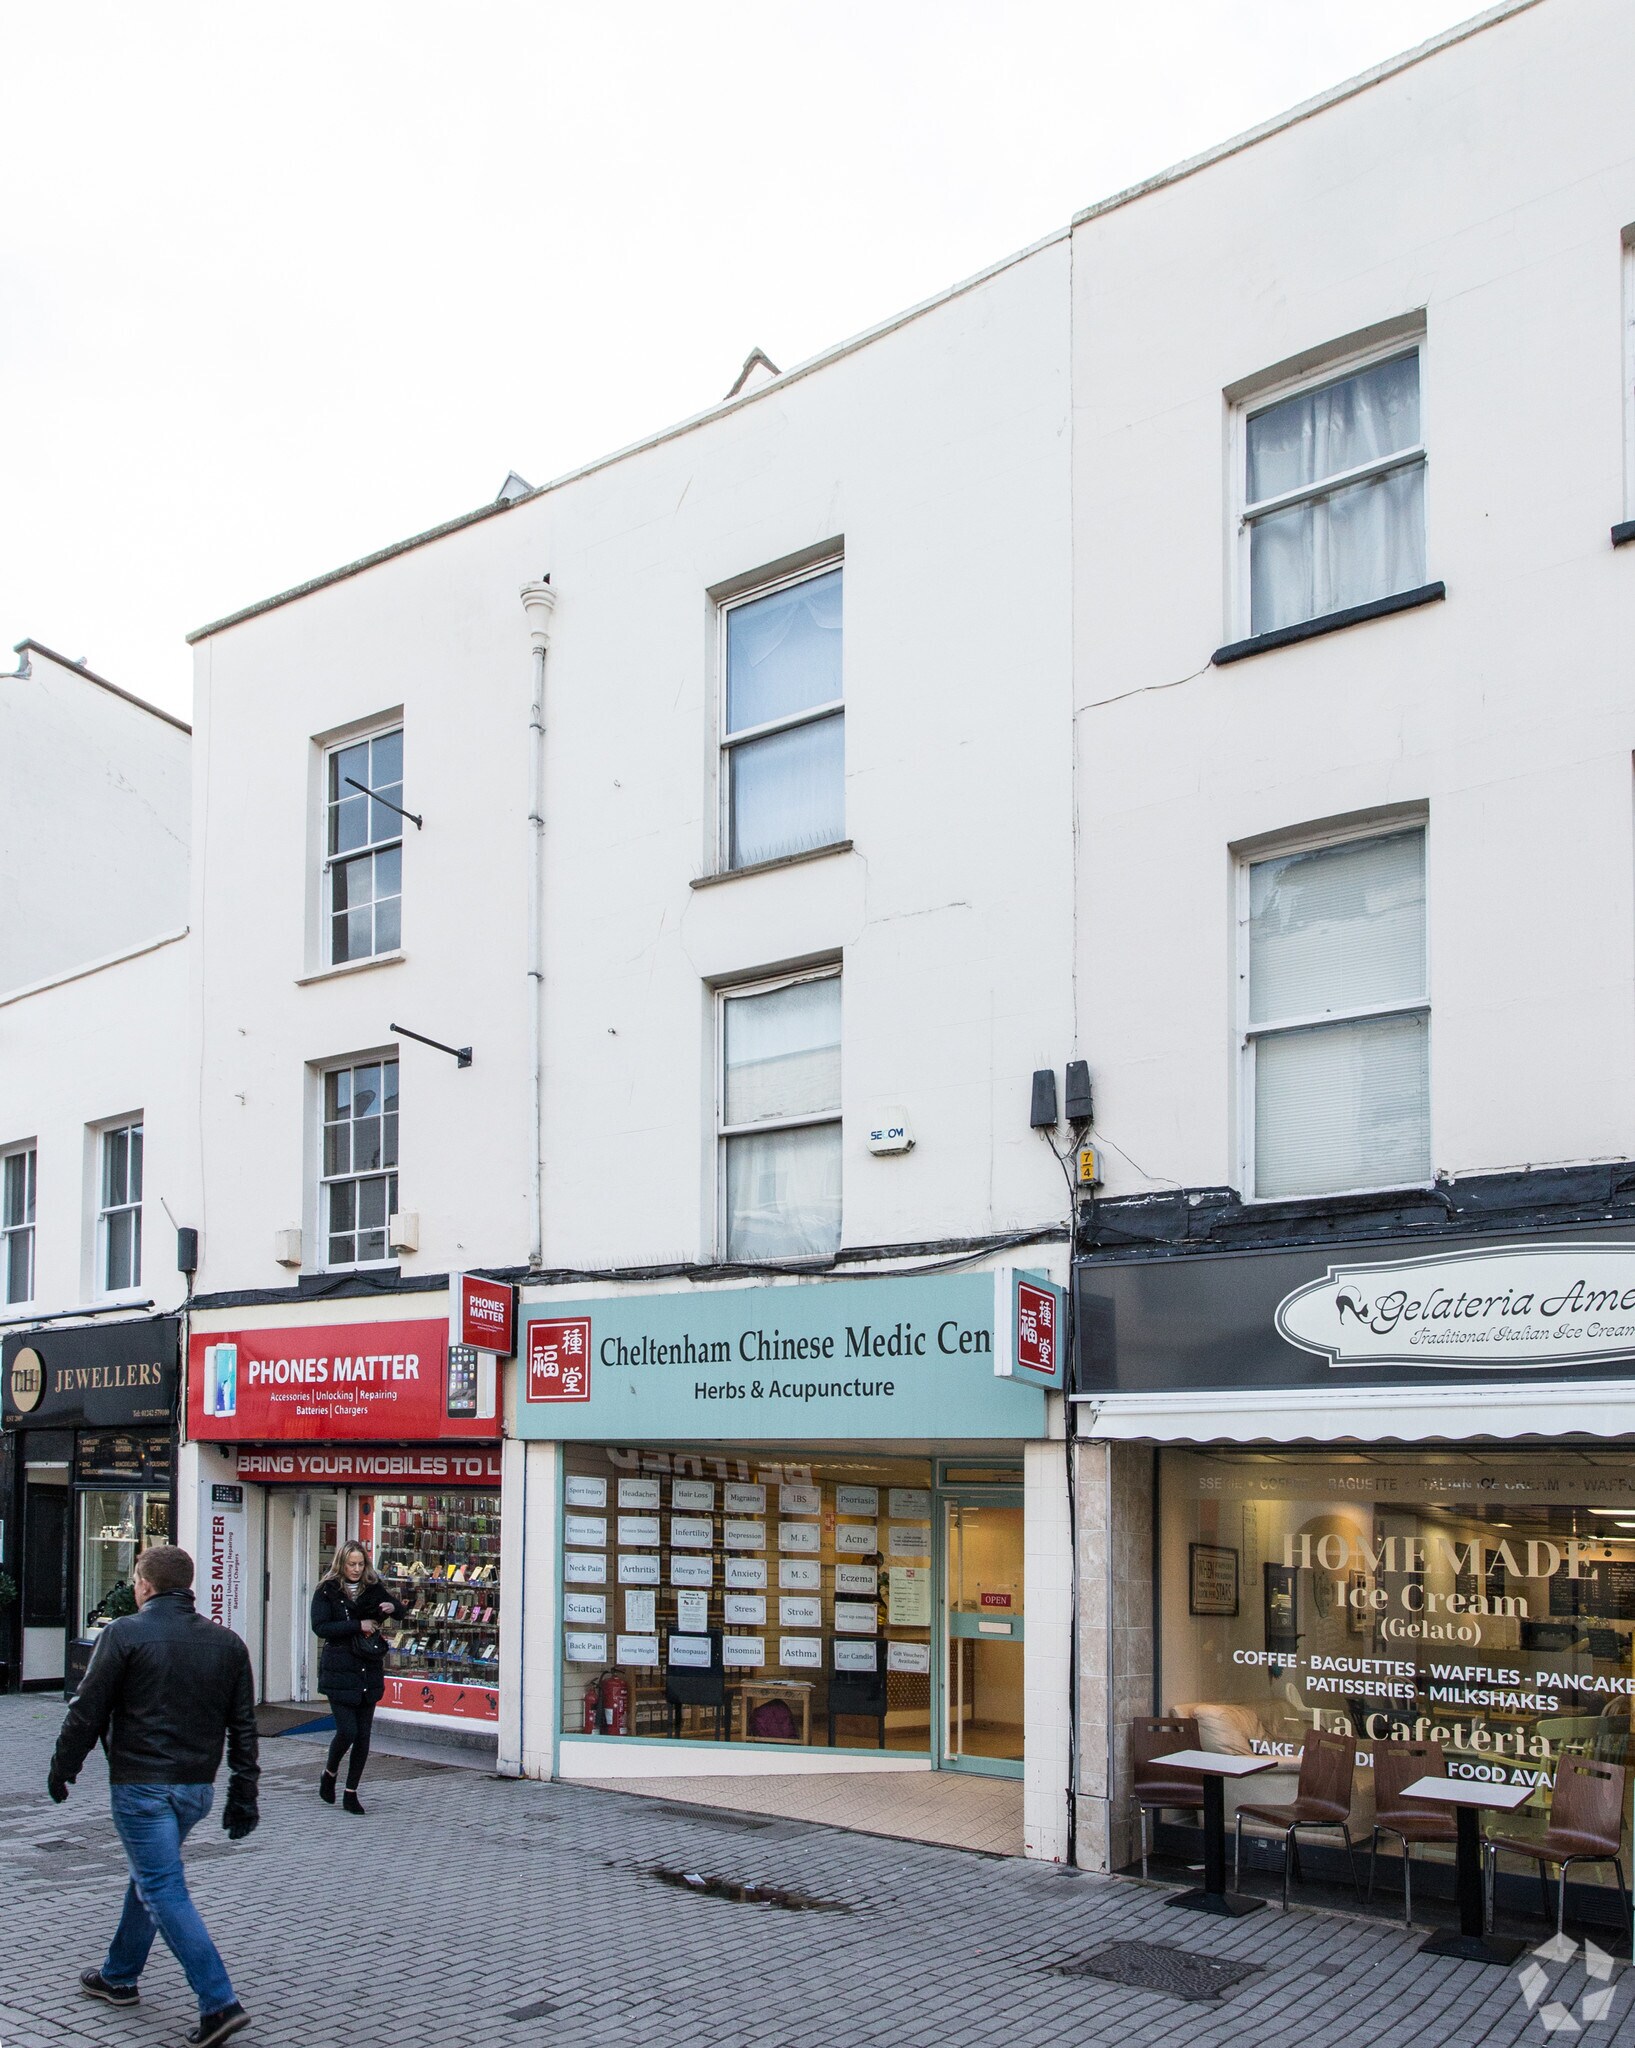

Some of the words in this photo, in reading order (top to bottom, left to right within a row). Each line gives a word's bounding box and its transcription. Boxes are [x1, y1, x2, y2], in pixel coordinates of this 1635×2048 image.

[871, 1128, 903, 1140] SEOM
[1083, 1153, 1091, 1162] 7
[1083, 1168, 1091, 1177] 4
[469, 1295, 504, 1312] PHONES
[1371, 1287, 1535, 1334] Gelateria
[1540, 1279, 1635, 1317] Ame
[470, 1307, 504, 1323] MATTER
[1410, 1326, 1491, 1345] Traditional
[1493, 1324, 1550, 1342] Italian
[1553, 1323, 1582, 1339] Ice
[600, 1334, 731, 1366] Cheltenham
[739, 1329, 834, 1361] Chinese
[845, 1323, 926, 1357] Medic
[937, 1321, 995, 1355] Cen
[249, 1357, 328, 1384] PHONES
[333, 1354, 419, 1381] MATTER
[55, 1362, 161, 1393] JEWELLERS
[695, 1382, 746, 1399] Herbs
[751, 1380, 764, 1398] &
[769, 1378, 895, 1402] Acupuncture
[270, 1392, 310, 1402] Accessories
[316, 1391, 353, 1403] Unlocking
[360, 1390, 397, 1401] Repairing
[296, 1405, 328, 1415] Batteries
[334, 1404, 368, 1416] Chargers
[238, 1456, 294, 1473] BRING
[297, 1456, 351, 1474] YOUR
[356, 1457, 448, 1475] MOBILES
[451, 1458, 482, 1476] TO
[569, 1487, 584, 1496] Sport
[585, 1488, 602, 1497] Injury
[622, 1490, 657, 1498] Headaches
[678, 1490, 693, 1498] Hair
[694, 1491, 708, 1499] Loss
[730, 1494, 761, 1503] Migraine
[793, 1495, 807, 1503] IBS
[840, 1496, 875, 1505] Psoriasis
[675, 1529, 710, 1539] Infertility
[728, 1532, 762, 1540] Depression
[801, 1534, 809, 1542] E.
[845, 1534, 868, 1543] Acne
[212, 1516, 225, 1580] MATTER
[1282, 1533, 1599, 1580] HOMEMADE
[569, 1564, 586, 1572] Neck
[623, 1565, 656, 1574] Arthritis
[674, 1567, 696, 1576] Allergy
[731, 1569, 762, 1579] Anxiety
[802, 1571, 809, 1579] S.
[840, 1573, 873, 1584] Eczema
[985, 1595, 1007, 1605] OPEN
[1336, 1580, 1388, 1610] Ice
[1401, 1583, 1530, 1619] Cream
[211, 1584, 224, 1626] ONES
[568, 1604, 602, 1613] Sciatica
[734, 1605, 757, 1613] Stress
[787, 1608, 814, 1616] Stroke
[1380, 1617, 1482, 1647] (Gelato)
[569, 1642, 586, 1650] Back
[727, 1647, 761, 1655] Insomnia
[673, 1647, 707, 1656] Menopause
[785, 1649, 817, 1658] Asthma
[851, 1652, 873, 1660] Candle
[1233, 1650, 1297, 1668] COFFEE
[1310, 1655, 1416, 1677] BAGUETTES
[1430, 1664, 1520, 1685] WAFFLES
[1536, 1671, 1635, 1695] PANCAKE
[1306, 1676, 1415, 1699] PATISSERIES
[1430, 1686, 1559, 1711] MILKSHAKES
[1365, 1713, 1552, 1758] Cafetéria
[1249, 1739, 1295, 1758] TAKE
[1448, 1762, 1506, 1783] FOOD
